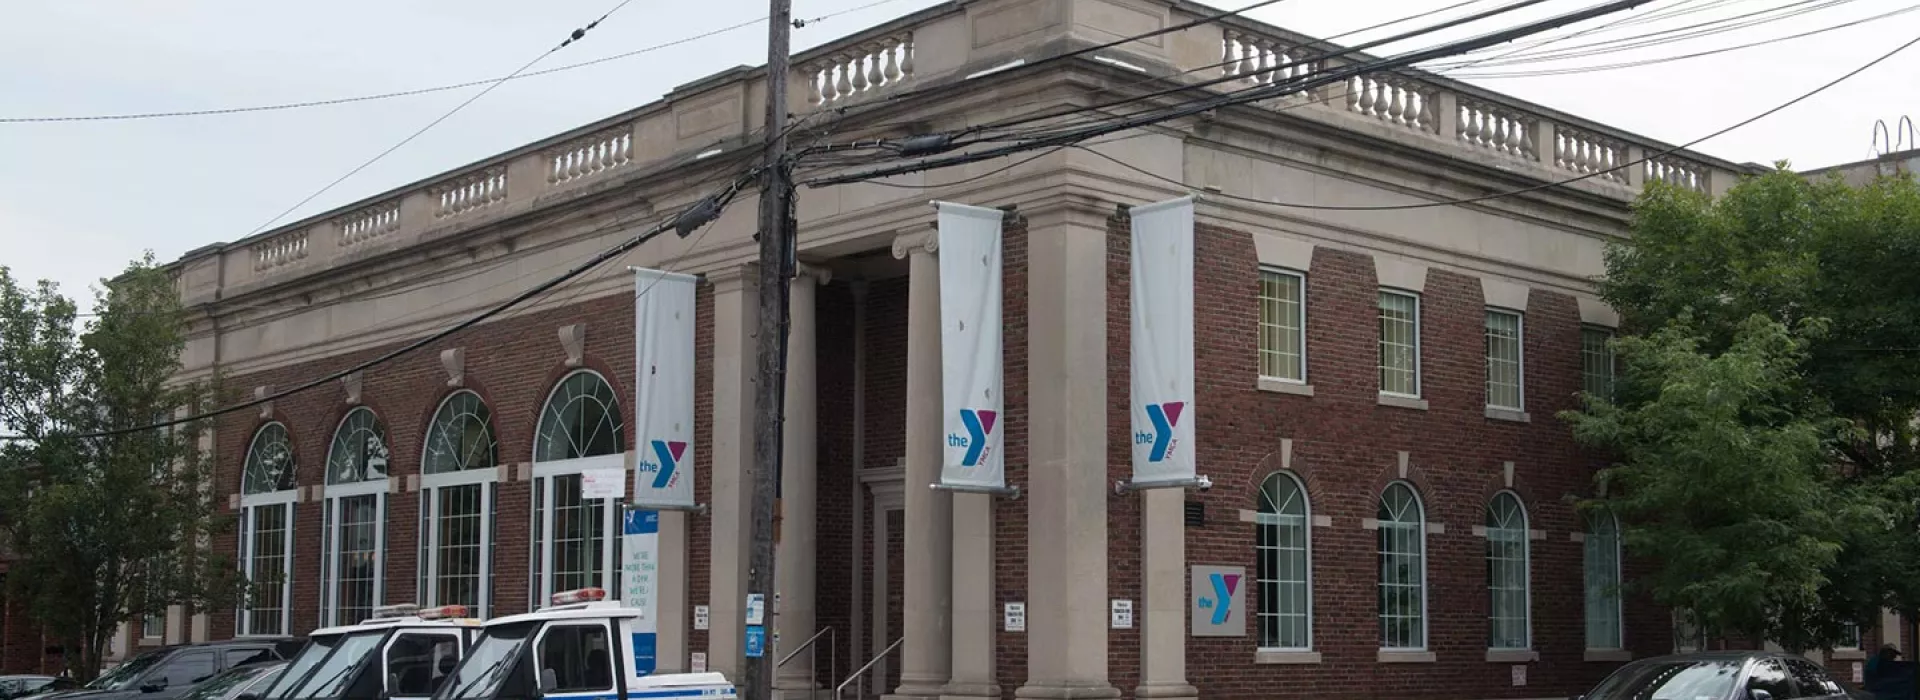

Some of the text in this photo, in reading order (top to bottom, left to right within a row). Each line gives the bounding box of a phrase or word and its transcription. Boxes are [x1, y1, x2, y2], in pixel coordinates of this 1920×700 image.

[947, 433, 968, 447] the
[1135, 430, 1153, 445] the
[1165, 438, 1178, 460] YMCA
[977, 446, 991, 467] YMCA
[640, 460, 657, 473] the
[1198, 596, 1213, 608] the
